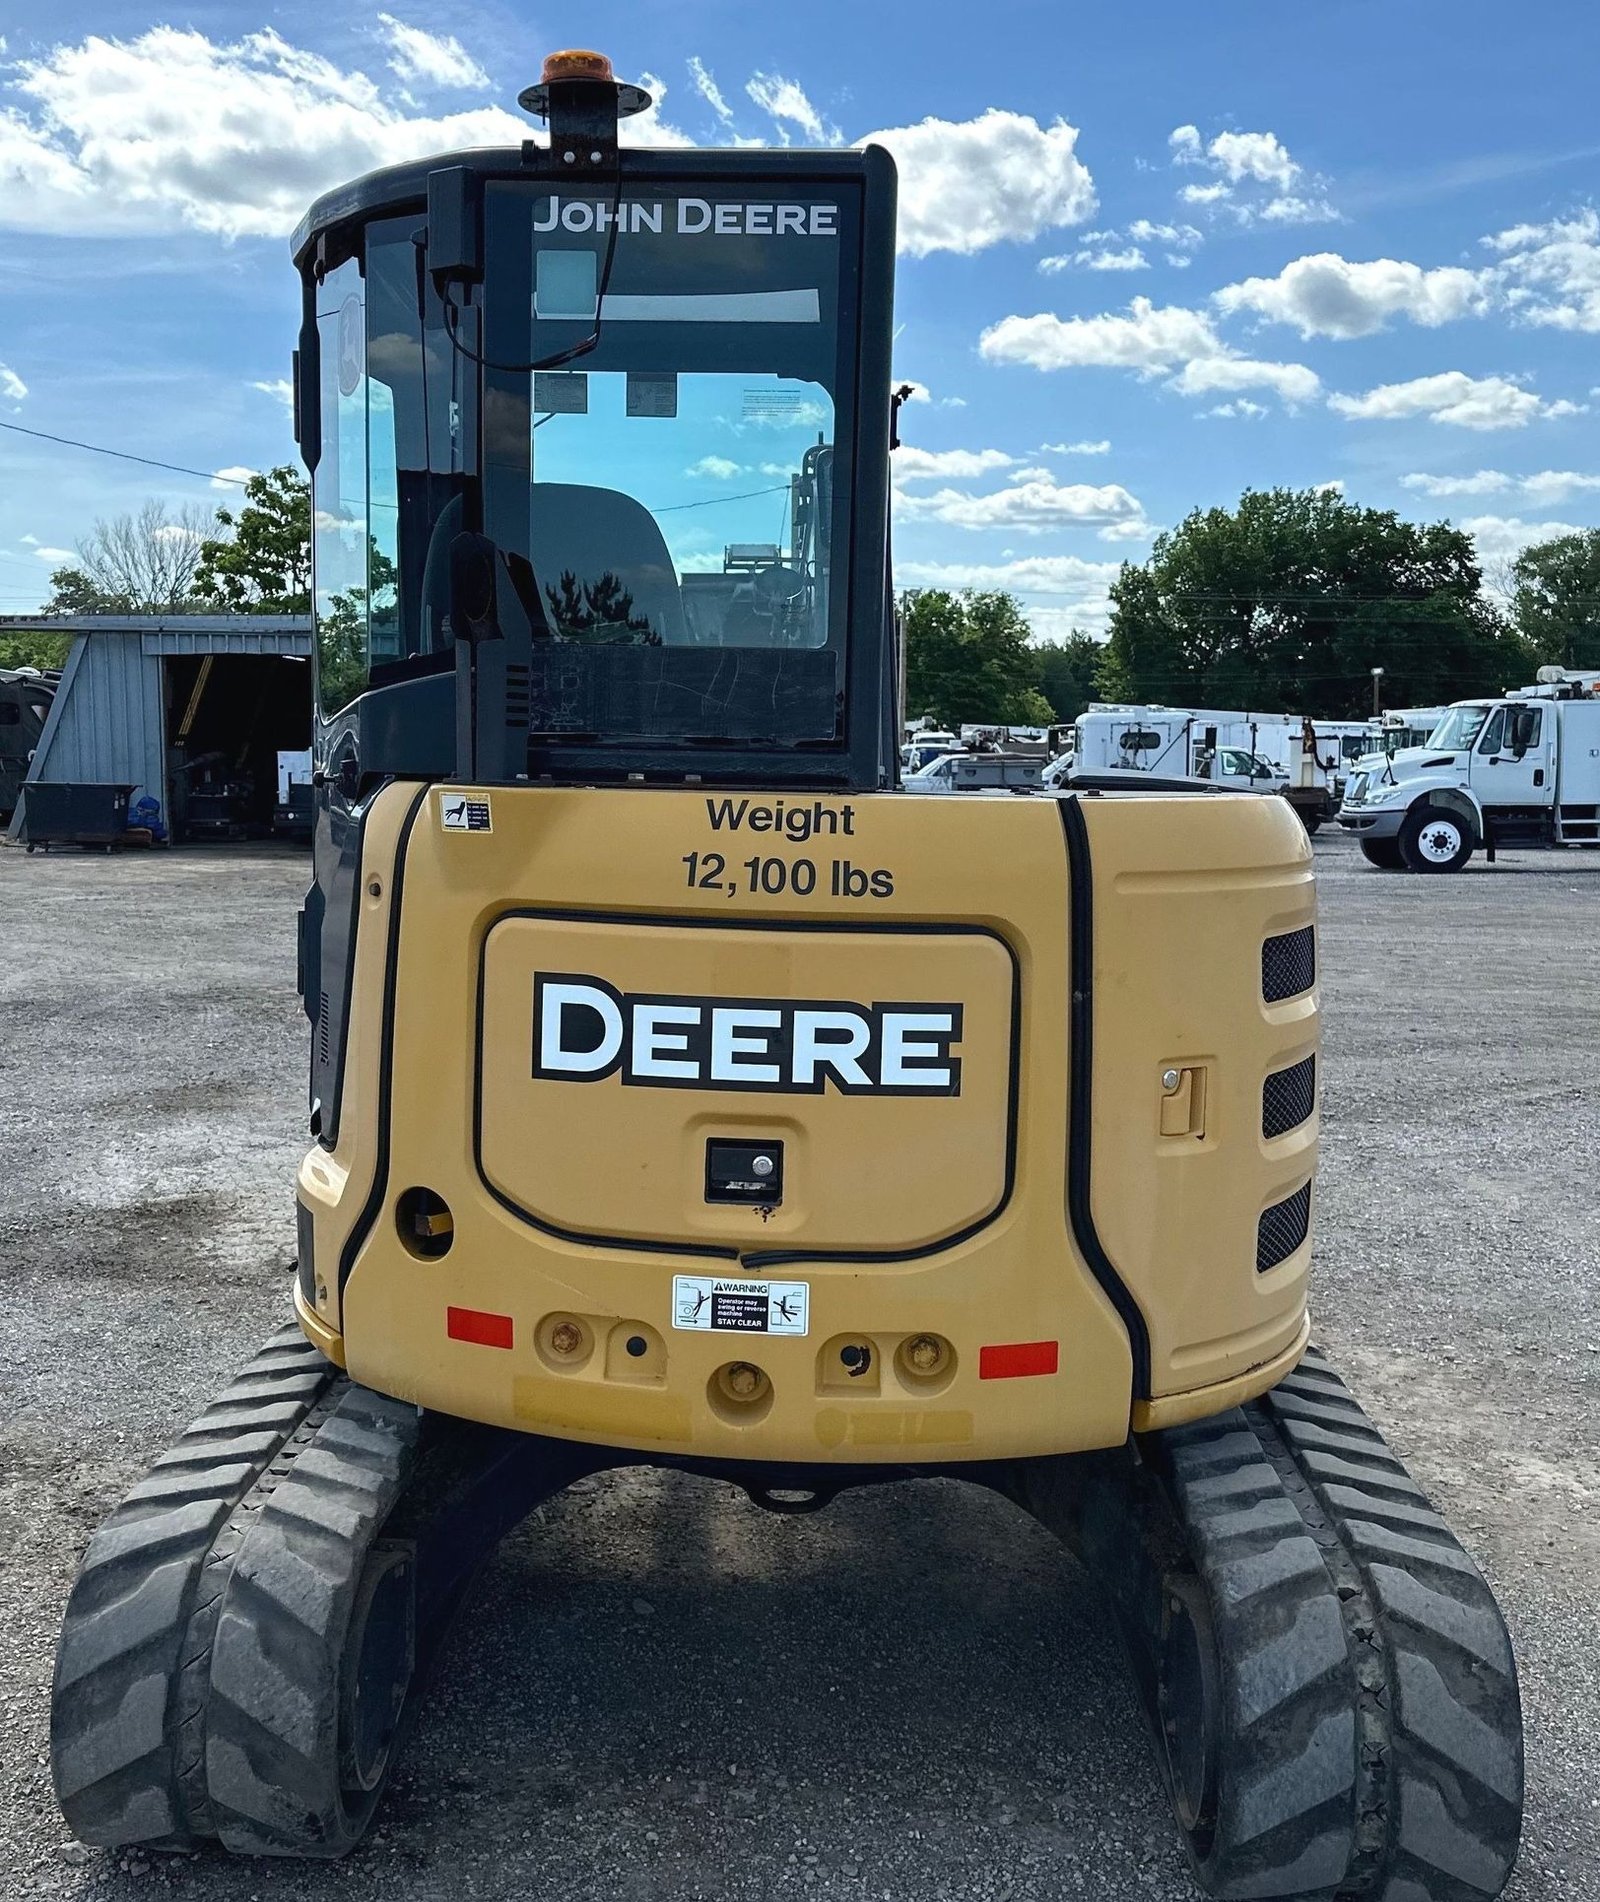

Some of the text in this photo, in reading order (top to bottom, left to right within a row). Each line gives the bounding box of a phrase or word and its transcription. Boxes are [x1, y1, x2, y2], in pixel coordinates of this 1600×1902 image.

[534, 196, 838, 235] JOHN DEERE
[705, 798, 855, 842] Weight
[682, 851, 894, 898] 12,100 lbs
[540, 982, 953, 1087] DEERE
[723, 1283, 767, 1293] WARNING
